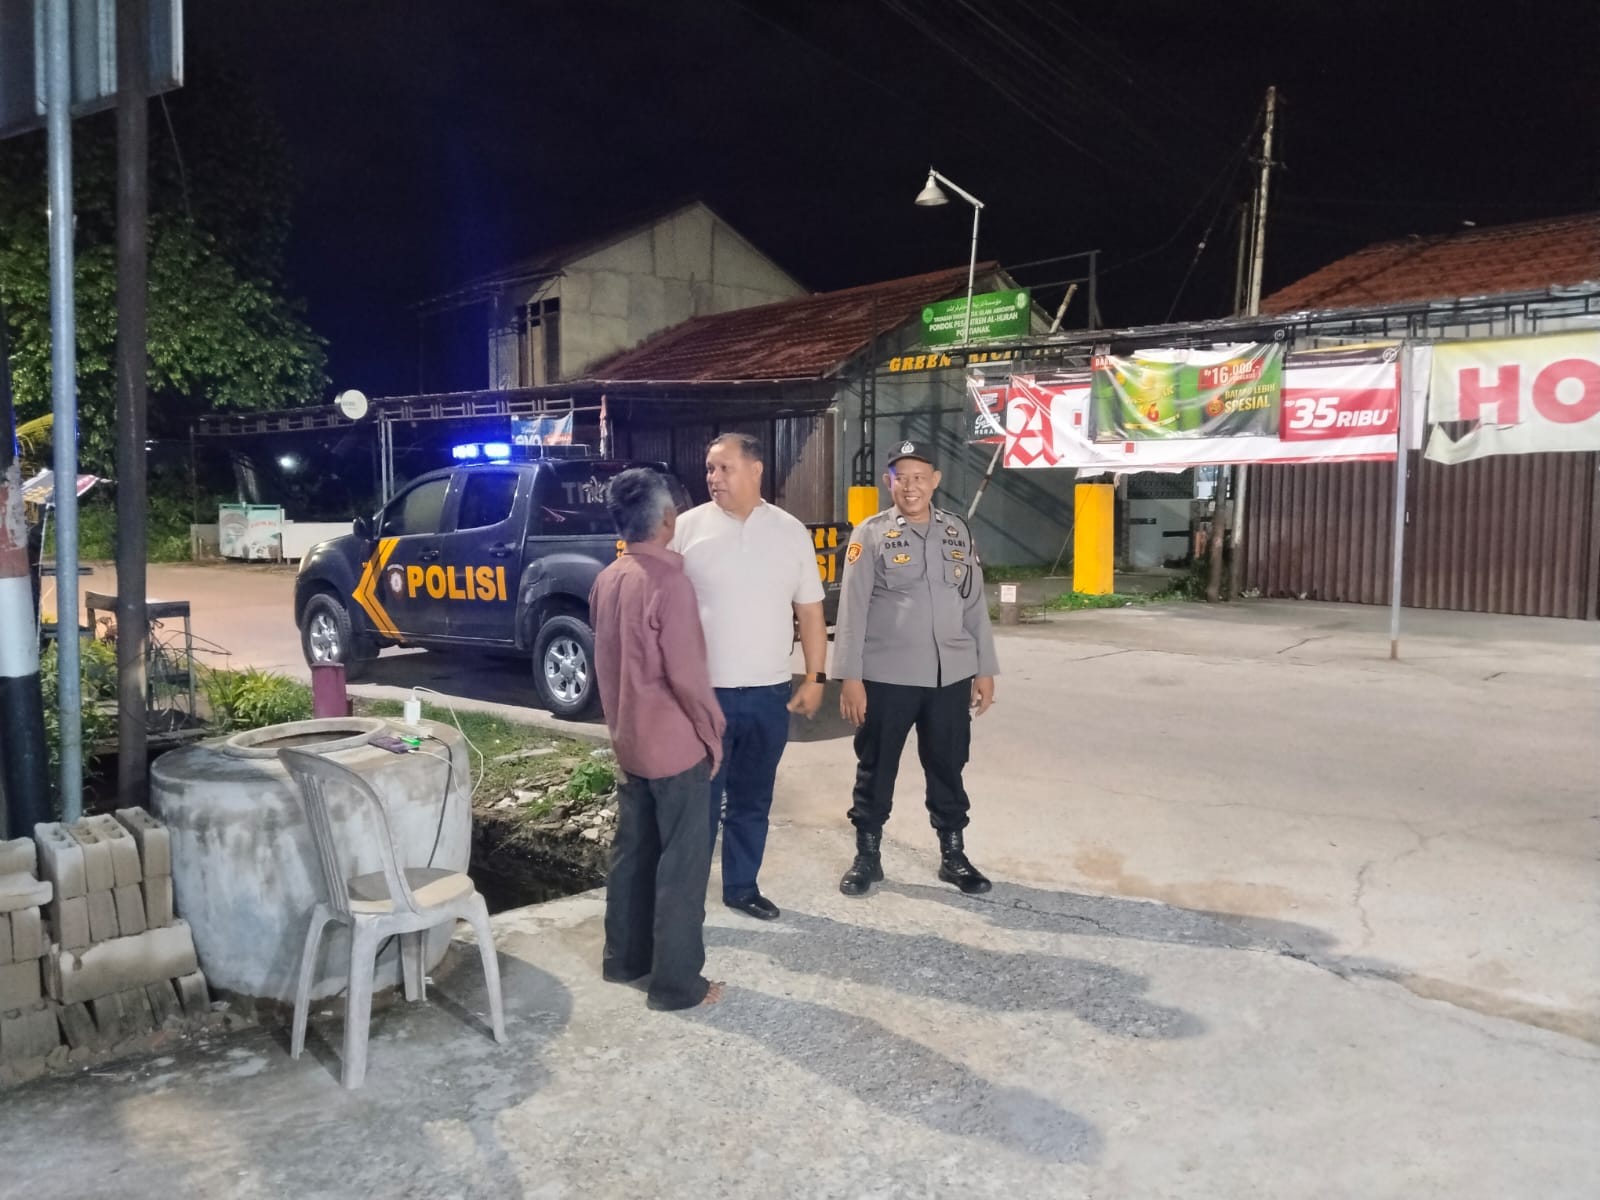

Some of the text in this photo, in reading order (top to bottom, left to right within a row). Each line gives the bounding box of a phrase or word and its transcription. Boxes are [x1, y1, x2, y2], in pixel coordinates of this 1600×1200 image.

[929, 321, 953, 332] PONDOK
[889, 353, 951, 372] GREEN
[1225, 395, 1271, 413] SPESIAL
[885, 540, 909, 549] DERA
[407, 565, 507, 600] POLISI
